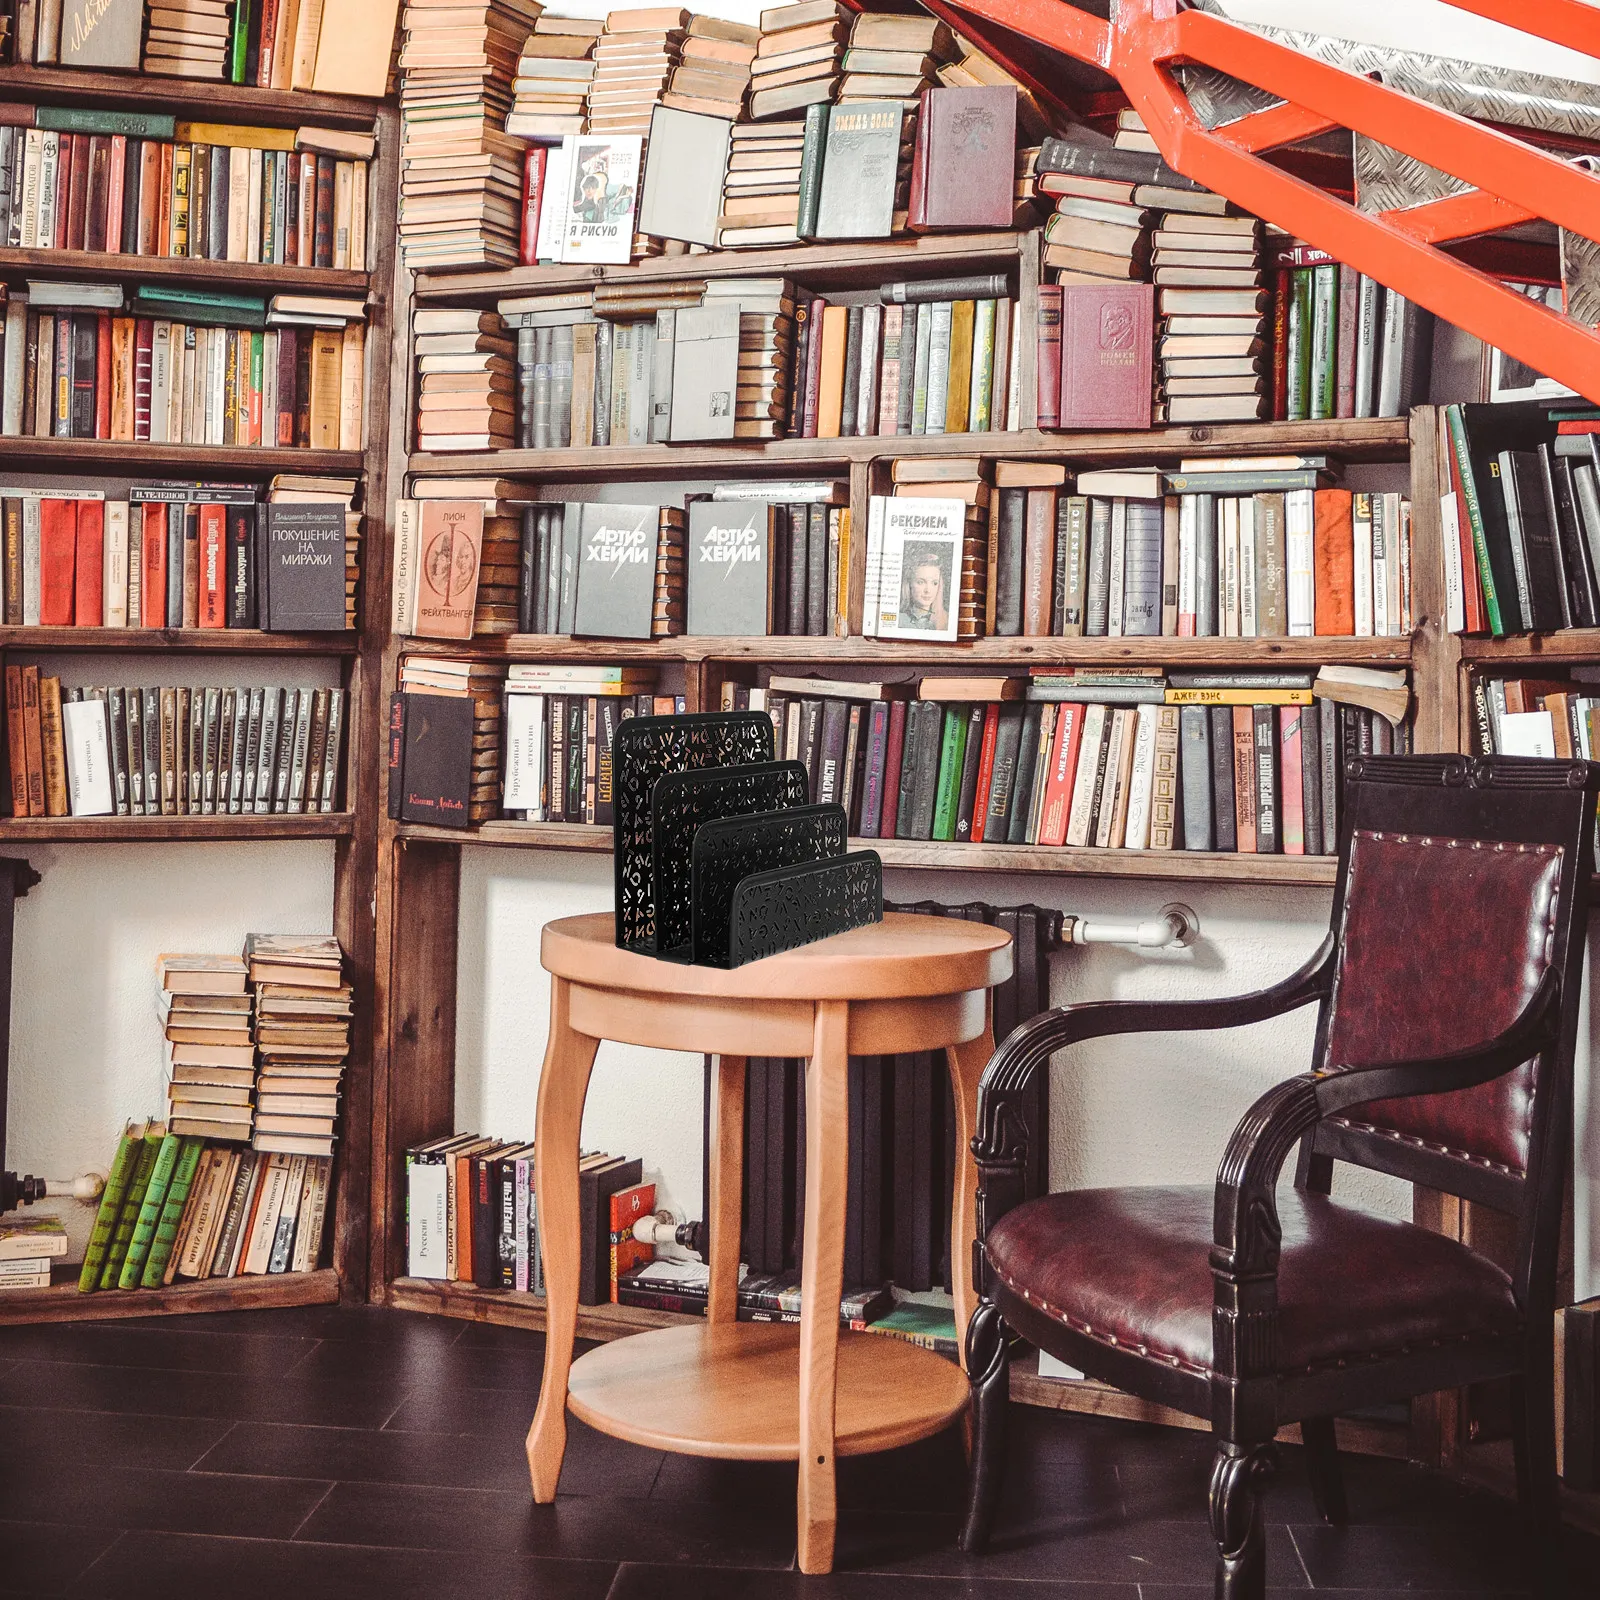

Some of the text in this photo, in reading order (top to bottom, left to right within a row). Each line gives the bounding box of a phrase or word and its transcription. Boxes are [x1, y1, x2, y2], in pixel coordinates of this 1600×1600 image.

[25, 164, 37, 245] ЧИНГИЗ АЙТМАТОВ
[570, 226, 618, 237] Я РИСУЮ
[1362, 320, 1370, 347] ОСКАР
[1458, 439, 1469, 469] веков
[8, 512, 17, 559] СИМОНОВ
[272, 530, 340, 541] ПОКУШЕНИЕ
[442, 513, 466, 522] ЛИОН
[890, 514, 948, 528] РЕКВИЕМ
[282, 554, 332, 565] МИРАЖИ
[298, 542, 315, 552] НА
[235, 547, 247, 593] Проскурин
[1031, 547, 1042, 601] АНАТОЛИЙ
[1514, 554, 1525, 587] вспомню
[397, 593, 406, 622] ЛИОН
[421, 609, 473, 619] ФЕЙХТВАНГЕР
[1519, 587, 1527, 604] Что
[1173, 691, 1221, 701] ДЖЕК ВЭНС
[1475, 686, 1487, 730] И ЖИЗНЬ
[84, 740, 94, 784] интересных
[248, 718, 258, 767] ЧИЧЕРИН
[262, 720, 275, 769] КОММУНИСТЫ
[279, 719, 293, 770] ГОНЧАРОВ
[296, 720, 307, 768] ВАШИНГТОН
[327, 730, 336, 766] ЛАВРОВ
[527, 725, 535, 769] детектив
[1056, 709, 1074, 782] Ф.НЕЗНАНСКИЙ
[511, 738, 522, 798] Зарубежный
[824, 759, 836, 791] КРИСТИ
[1092, 741, 1107, 818] ЗАРУБЕЖНЫЙ ДЕТЕКТИВ
[1259, 753, 1273, 834] ЦЕЛЬ-ПРЕЗИДЕНТ
[233, 1163, 251, 1207] ГАЙДАР
[261, 1170, 281, 1228] Три мушкетера
[502, 1180, 513, 1234] ПРЕДТЕЧИ
[435, 1192, 443, 1237] детектив
[419, 1218, 430, 1258] Русский
